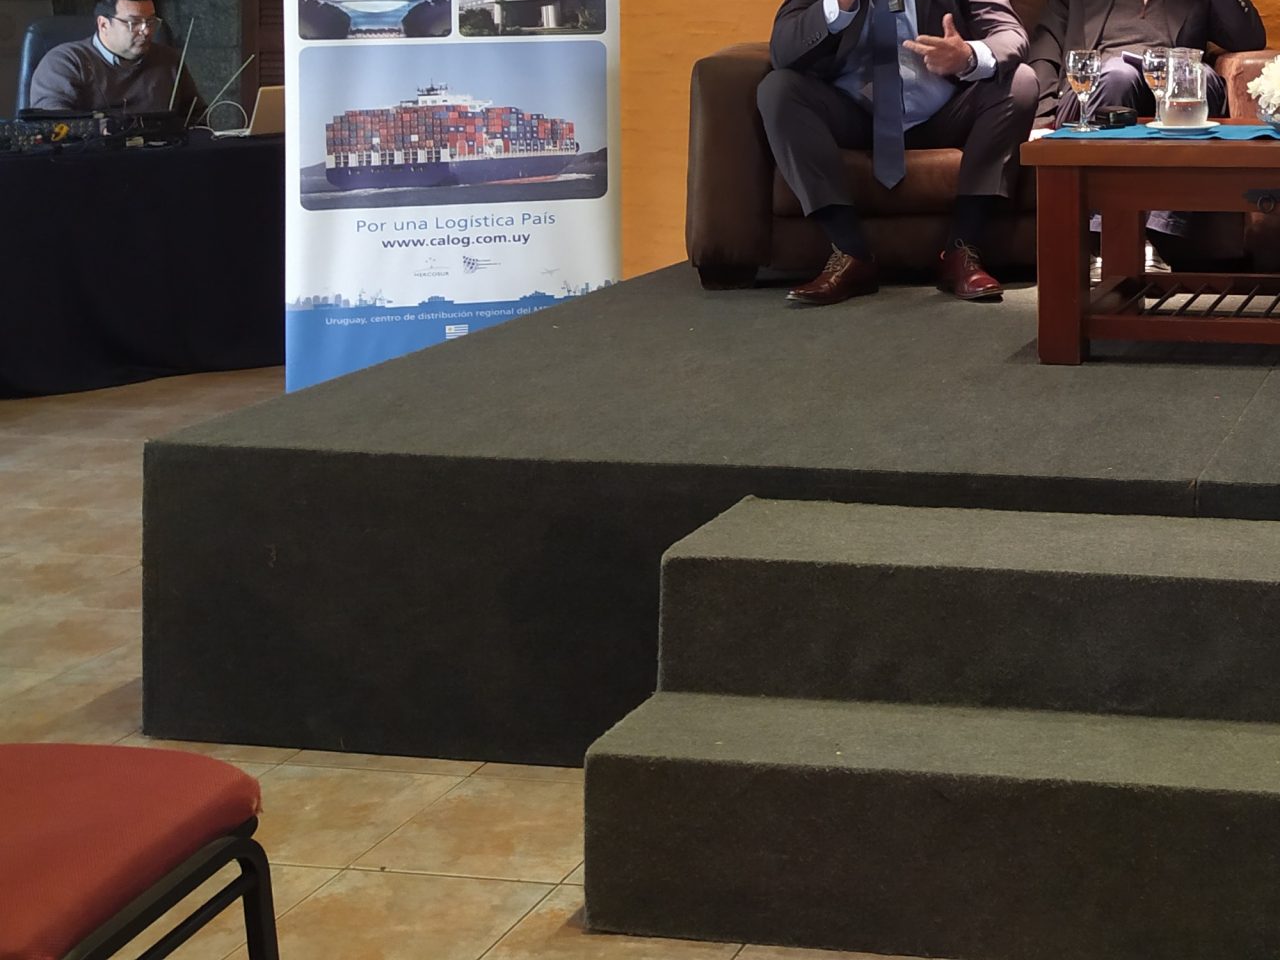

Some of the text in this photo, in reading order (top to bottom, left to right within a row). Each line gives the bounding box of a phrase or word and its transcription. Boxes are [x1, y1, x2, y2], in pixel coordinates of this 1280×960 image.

[356, 211, 556, 233] Por una Logística País
[381, 233, 531, 248] www.calog.com.uy
[325, 316, 368, 326] Uruguay,
[370, 315, 401, 323] centro
[404, 313, 415, 321] de
[417, 310, 473, 321] distribución
[475, 307, 514, 318] regional
[516, 306, 531, 315] del
